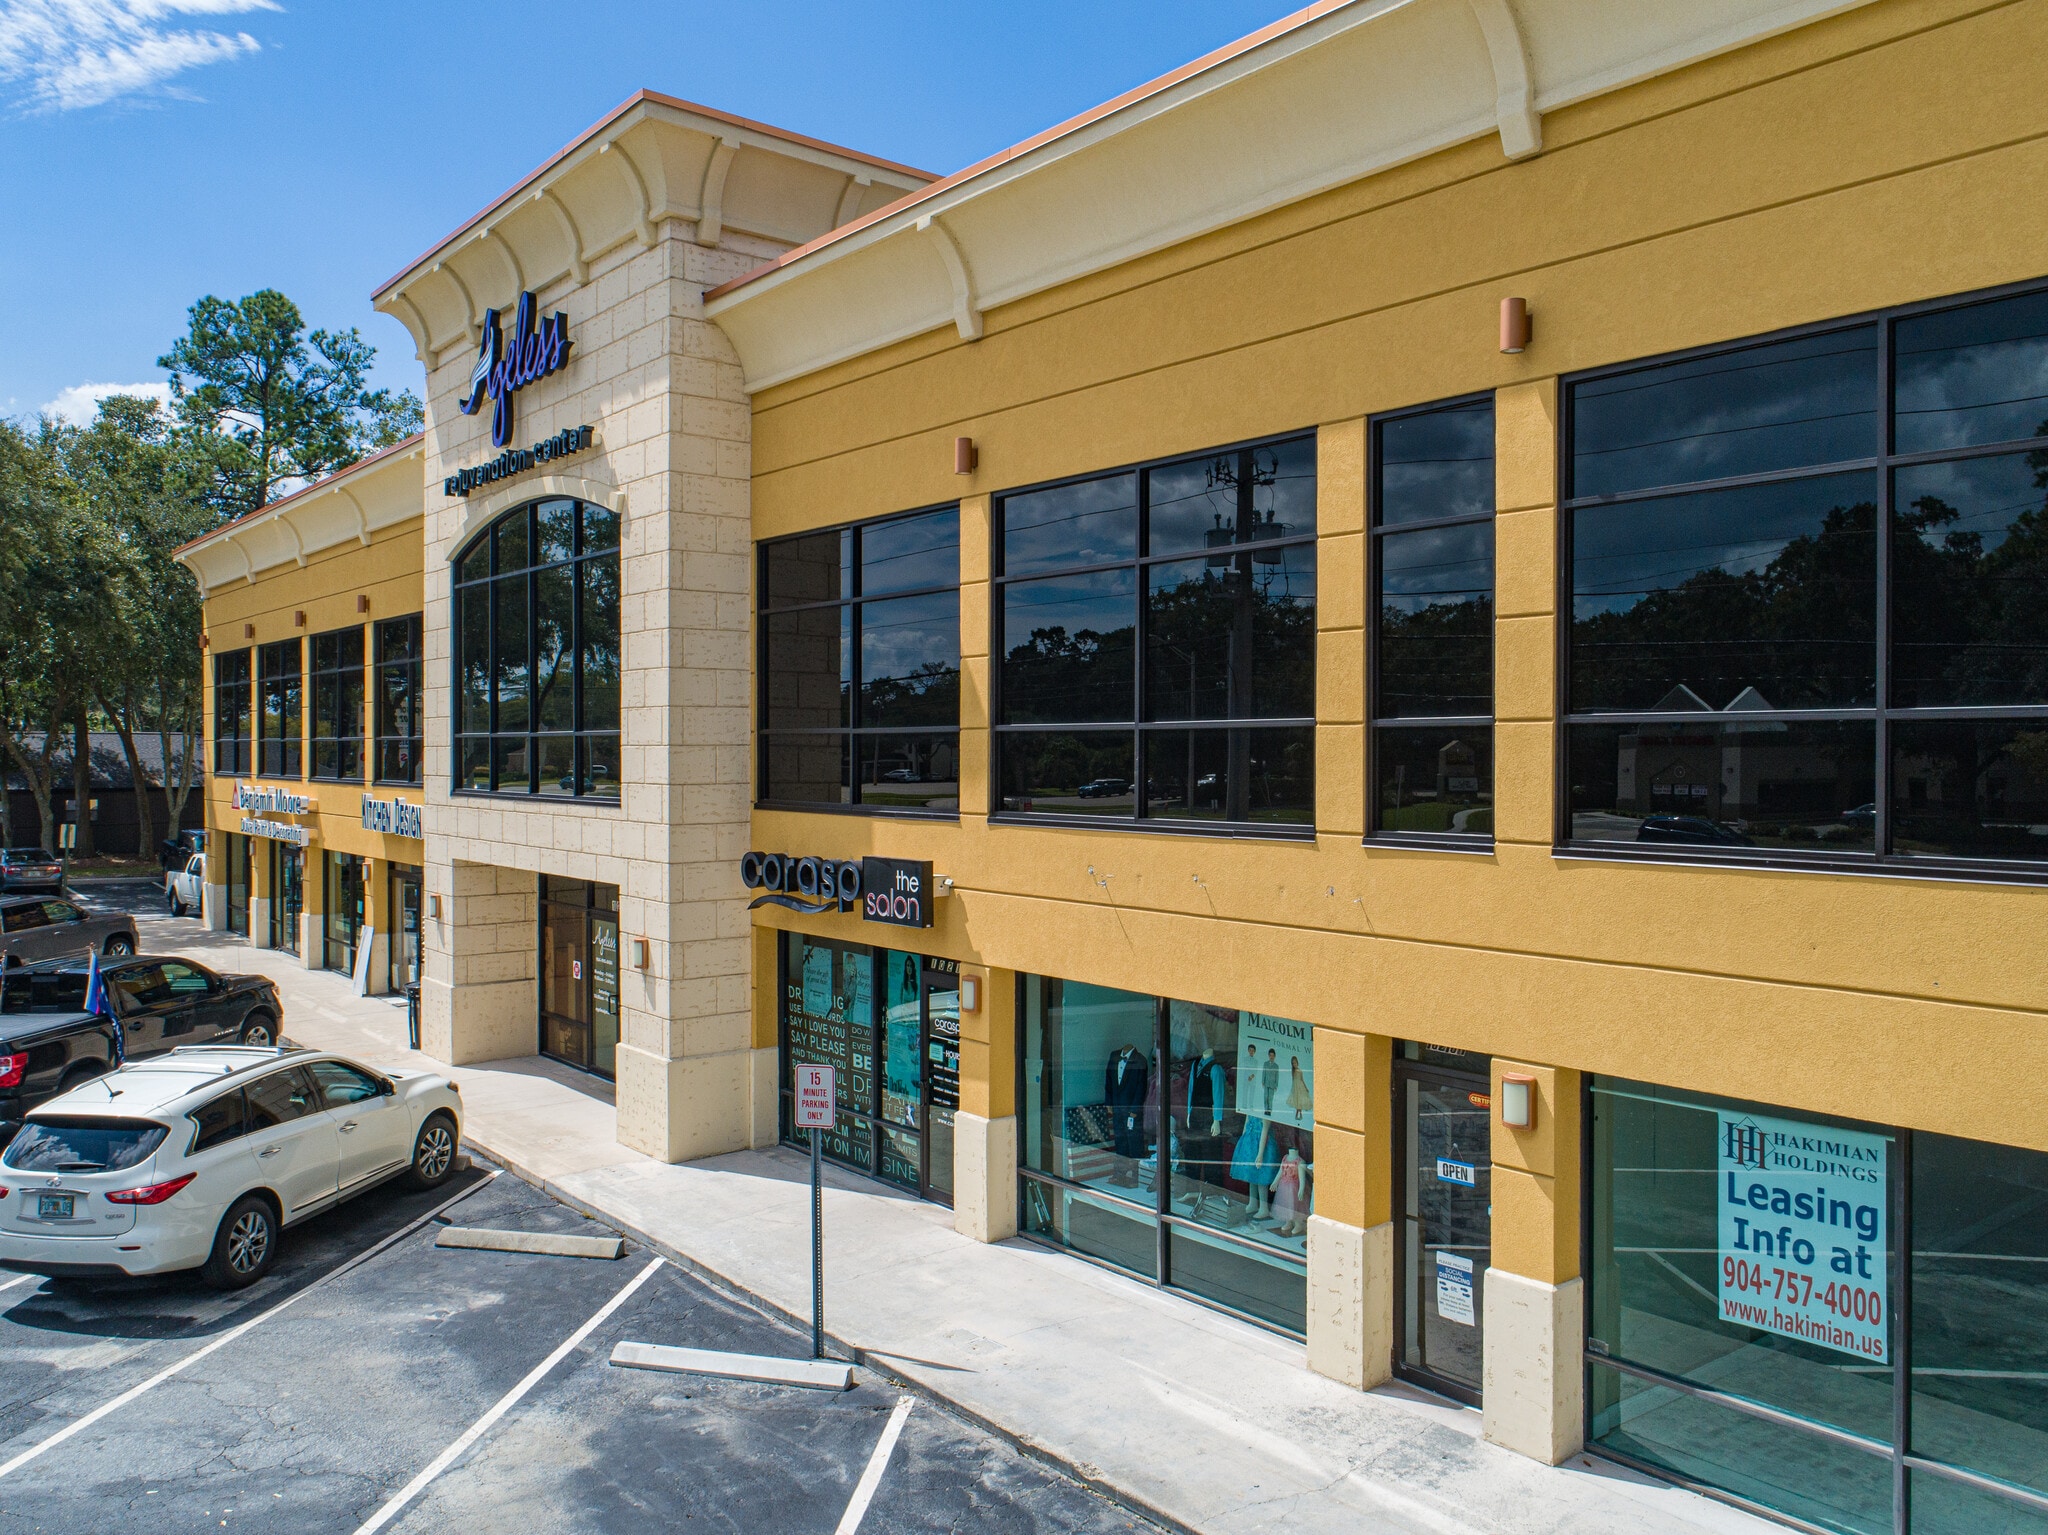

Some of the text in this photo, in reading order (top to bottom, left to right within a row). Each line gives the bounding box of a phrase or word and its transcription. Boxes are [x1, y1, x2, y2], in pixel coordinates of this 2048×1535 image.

[459, 290, 576, 448] Ageless
[444, 425, 594, 497] rejuvenation center
[240, 785, 303, 815] Benjamin Moore
[362, 793, 422, 839] KITCHEN DESIGN
[272, 822, 302, 846] Decorating
[741, 851, 862, 913] corasp
[896, 869, 919, 893] the
[866, 888, 920, 921] salon
[789, 1003, 802, 1015] USE
[789, 1015, 803, 1028] SAY
[809, 1021, 828, 1035] LOVE
[829, 1025, 846, 1039] YOU
[851, 1026, 863, 1035] DO
[1247, 1011, 1306, 1040] MALCOLM
[791, 1029, 846, 1057] SAY PLEASE
[1273, 1038, 1301, 1053] FORMAL
[792, 1046, 806, 1058] AND
[806, 1050, 830, 1065] THANK
[831, 1058, 847, 1070] YOU
[810, 1072, 821, 1086] 15
[801, 1099, 829, 1109] PARKING
[803, 1088, 828, 1098] MINUTE
[807, 1111, 824, 1120] ONLY
[833, 1138, 850, 1157] ON
[1773, 1131, 1879, 1163] HAKIMIAN
[1442, 1162, 1468, 1181] OPEN
[1773, 1151, 1879, 1184] HOLDINGS
[1727, 1171, 1879, 1242] Leasing
[1733, 1216, 1873, 1280] Info at
[1438, 1259, 1471, 1272] PLEASE PRACTICE
[1445, 1267, 1464, 1278] SOCIAL
[1438, 1271, 1471, 1286] DISTANCING
[1723, 1255, 1882, 1326] 904-757-4000
[1724, 1298, 1883, 1358] www.hakimian.us
